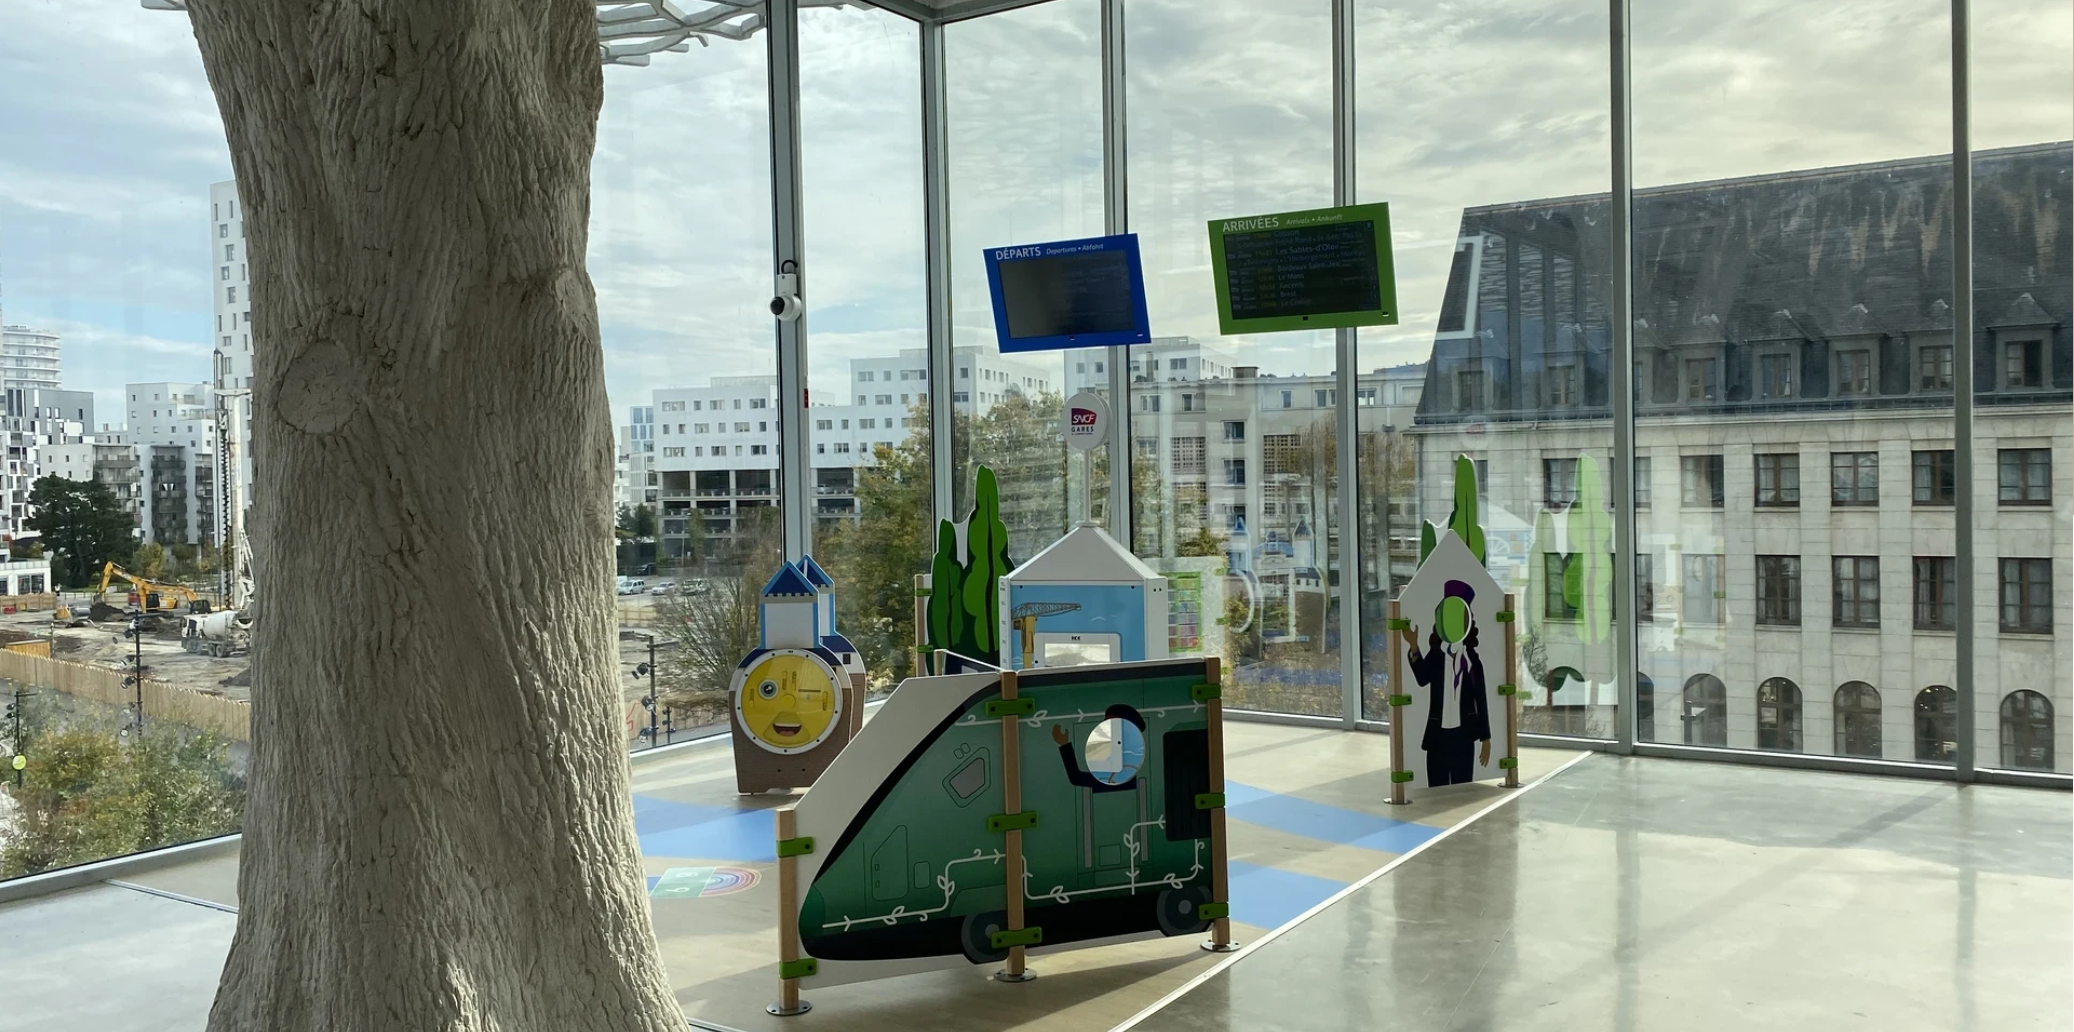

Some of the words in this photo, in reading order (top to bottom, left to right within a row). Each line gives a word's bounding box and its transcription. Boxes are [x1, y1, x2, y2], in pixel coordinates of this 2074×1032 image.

[1222, 216, 1280, 233] ARRIVÉES
[1286, 217, 1310, 226] Arrivals
[1316, 213, 1343, 222] Ankunft
[995, 246, 1041, 261] DÉPARTS
[1046, 246, 1077, 255] Departures
[1082, 243, 1104, 251] Abfahrt
[1072, 414, 1095, 424] SNCF
